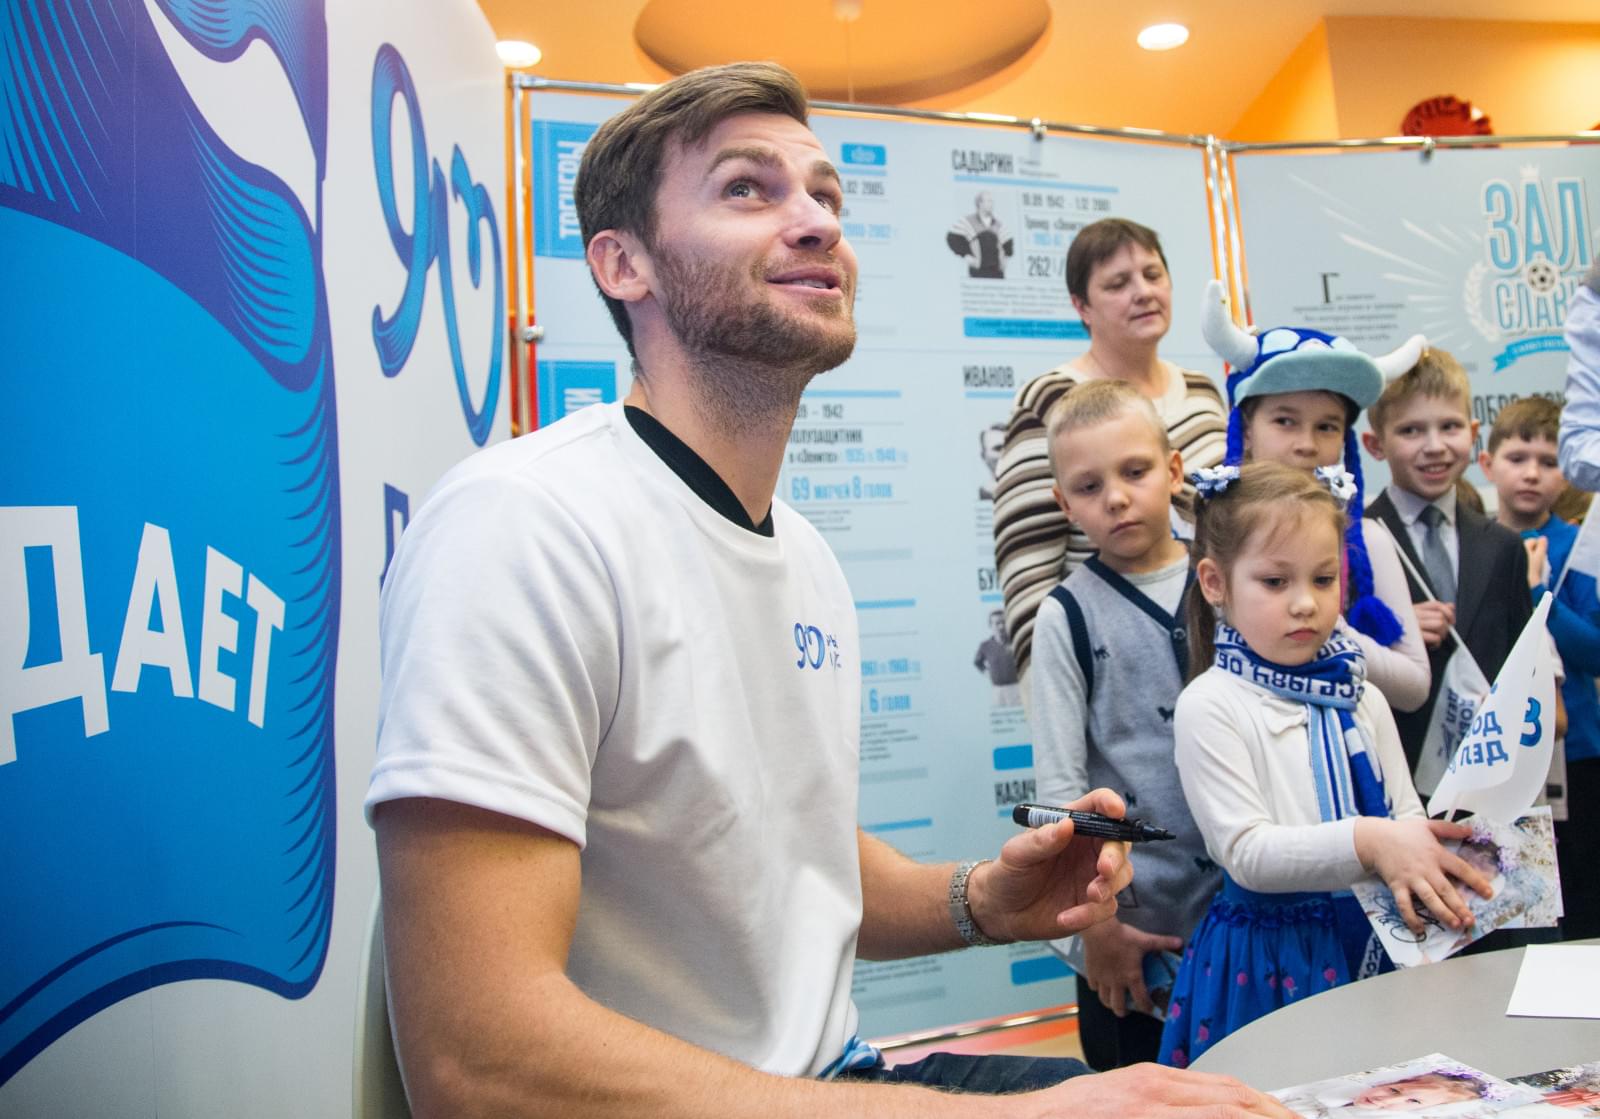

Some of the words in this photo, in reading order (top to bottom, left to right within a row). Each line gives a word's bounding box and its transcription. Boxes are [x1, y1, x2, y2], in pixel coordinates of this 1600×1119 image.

[1484, 179, 1590, 272] ЗАЛ
[1496, 281, 1575, 330] СЛАВ
[963, 366, 1014, 388] ИВАНОВ
